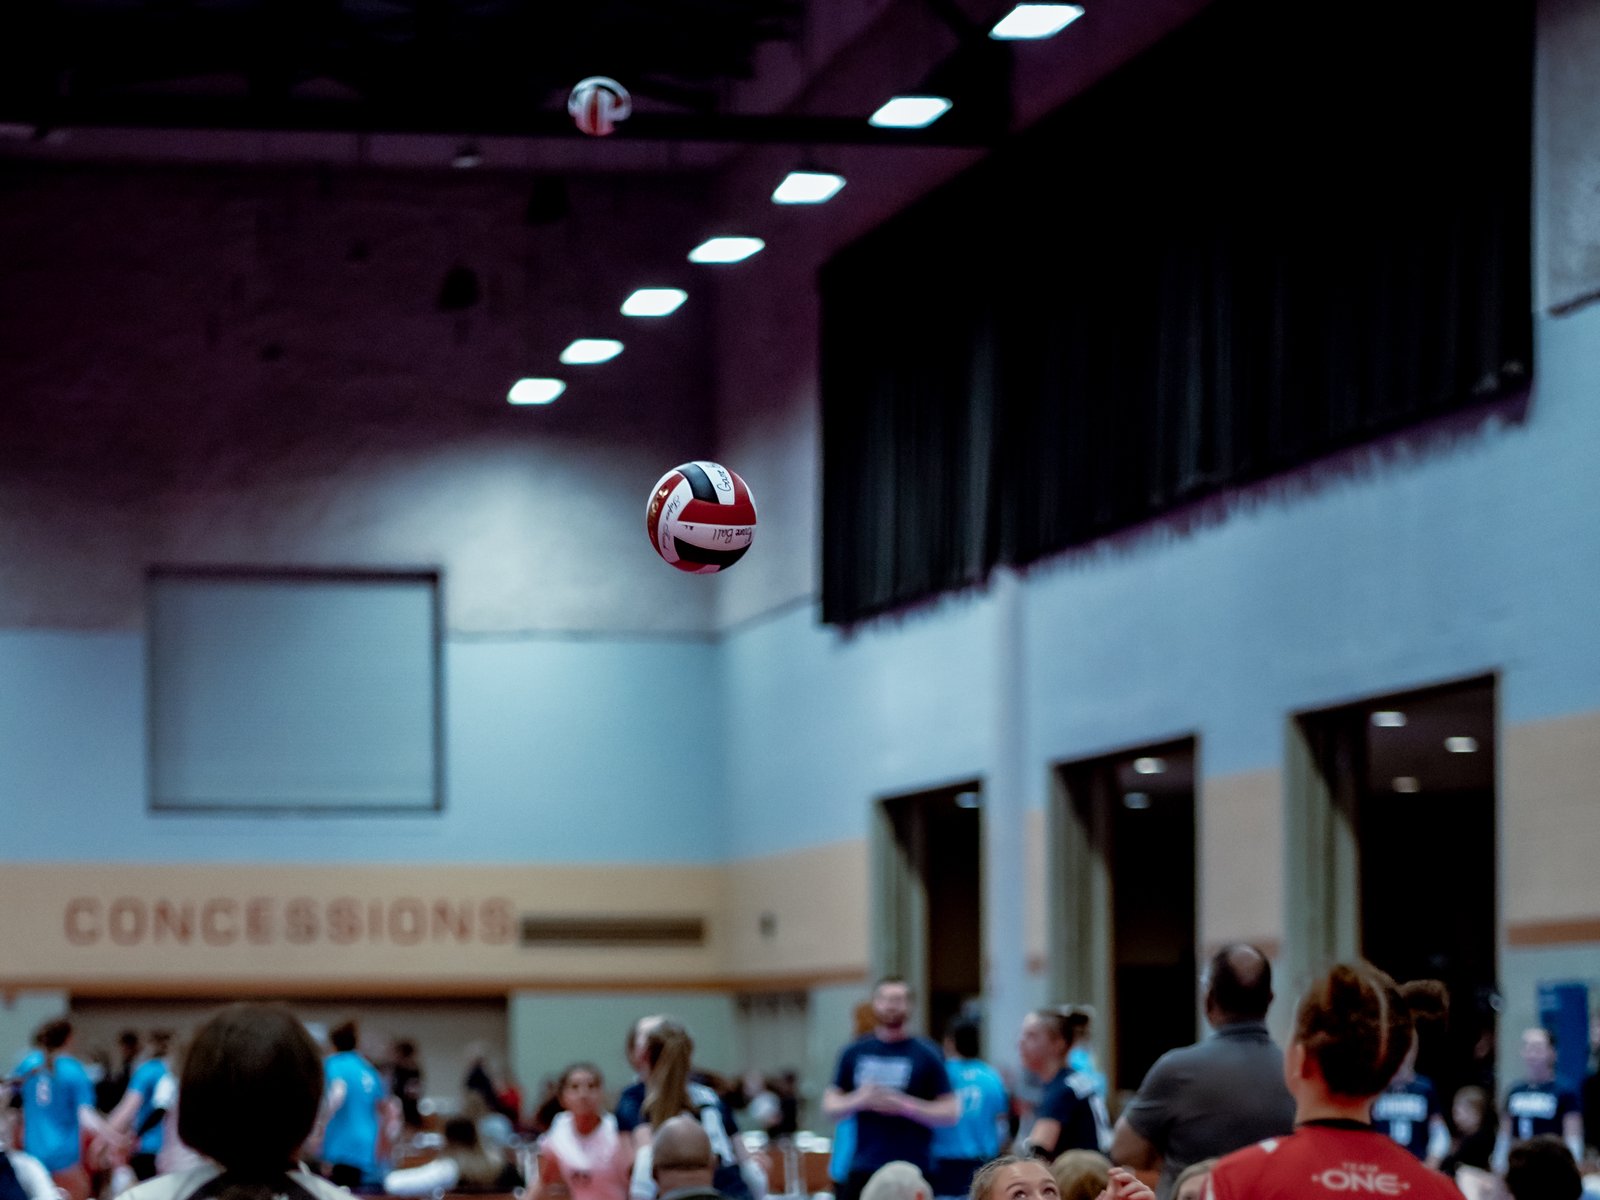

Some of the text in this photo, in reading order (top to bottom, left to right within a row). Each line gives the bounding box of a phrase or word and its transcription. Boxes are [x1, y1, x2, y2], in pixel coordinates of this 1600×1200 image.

[713, 528, 733, 544] Ball
[64, 897, 516, 946] CONCESSIONS
[1321, 1169, 1400, 1195] ONE
